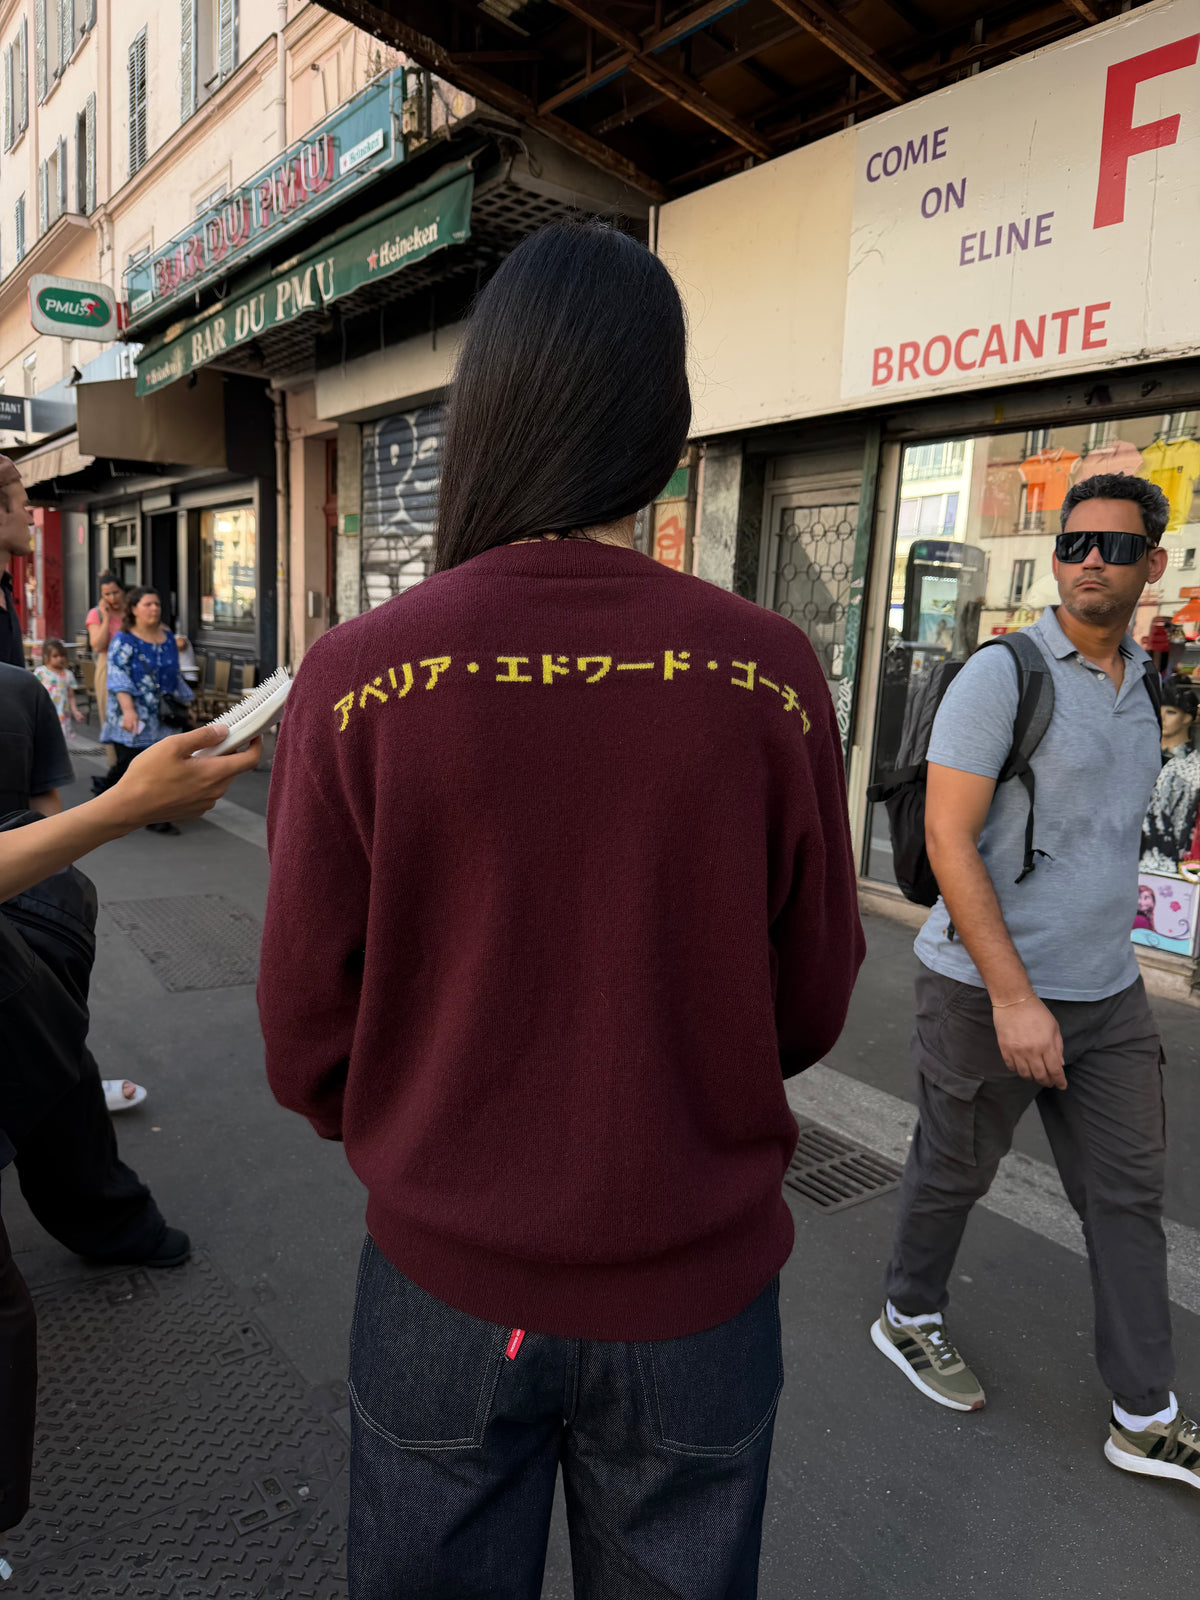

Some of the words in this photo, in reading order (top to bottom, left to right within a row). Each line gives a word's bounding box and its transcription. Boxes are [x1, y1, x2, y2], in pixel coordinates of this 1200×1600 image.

[866, 126, 949, 182] COME
[1093, 32, 1200, 230] F
[252, 133, 335, 229] PMU
[921, 177, 967, 219] ON
[379, 220, 439, 267] Heineken
[959, 211, 1055, 266] ELINE
[45, 298, 79, 316] PMU
[191, 318, 227, 367] BAR
[235, 293, 266, 341] DU
[275, 257, 335, 321] PMU
[871, 301, 1111, 387] BROCANTE
